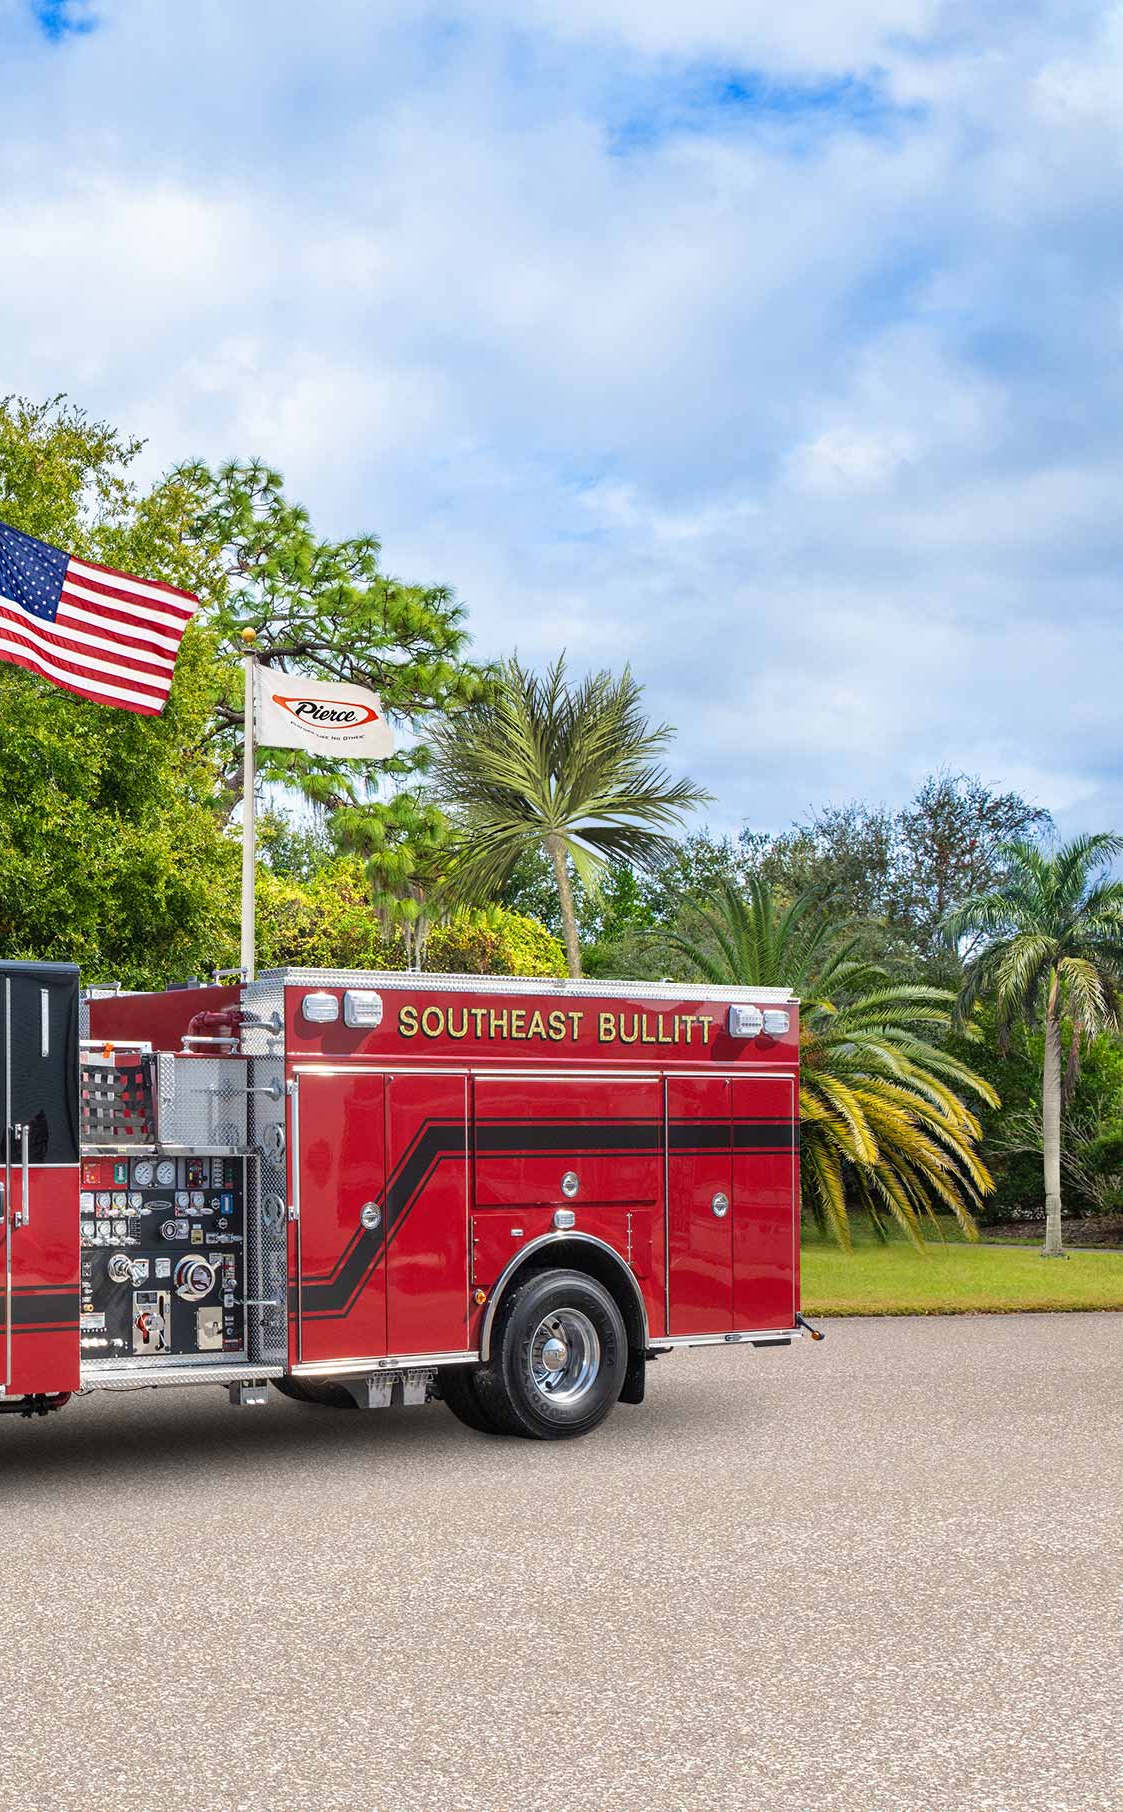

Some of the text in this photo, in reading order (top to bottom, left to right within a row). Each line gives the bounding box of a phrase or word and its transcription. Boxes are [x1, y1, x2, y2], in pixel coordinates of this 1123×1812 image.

[295, 701, 356, 722] Pierce
[398, 1005, 714, 1045] SOUTHEAST BULLITT
